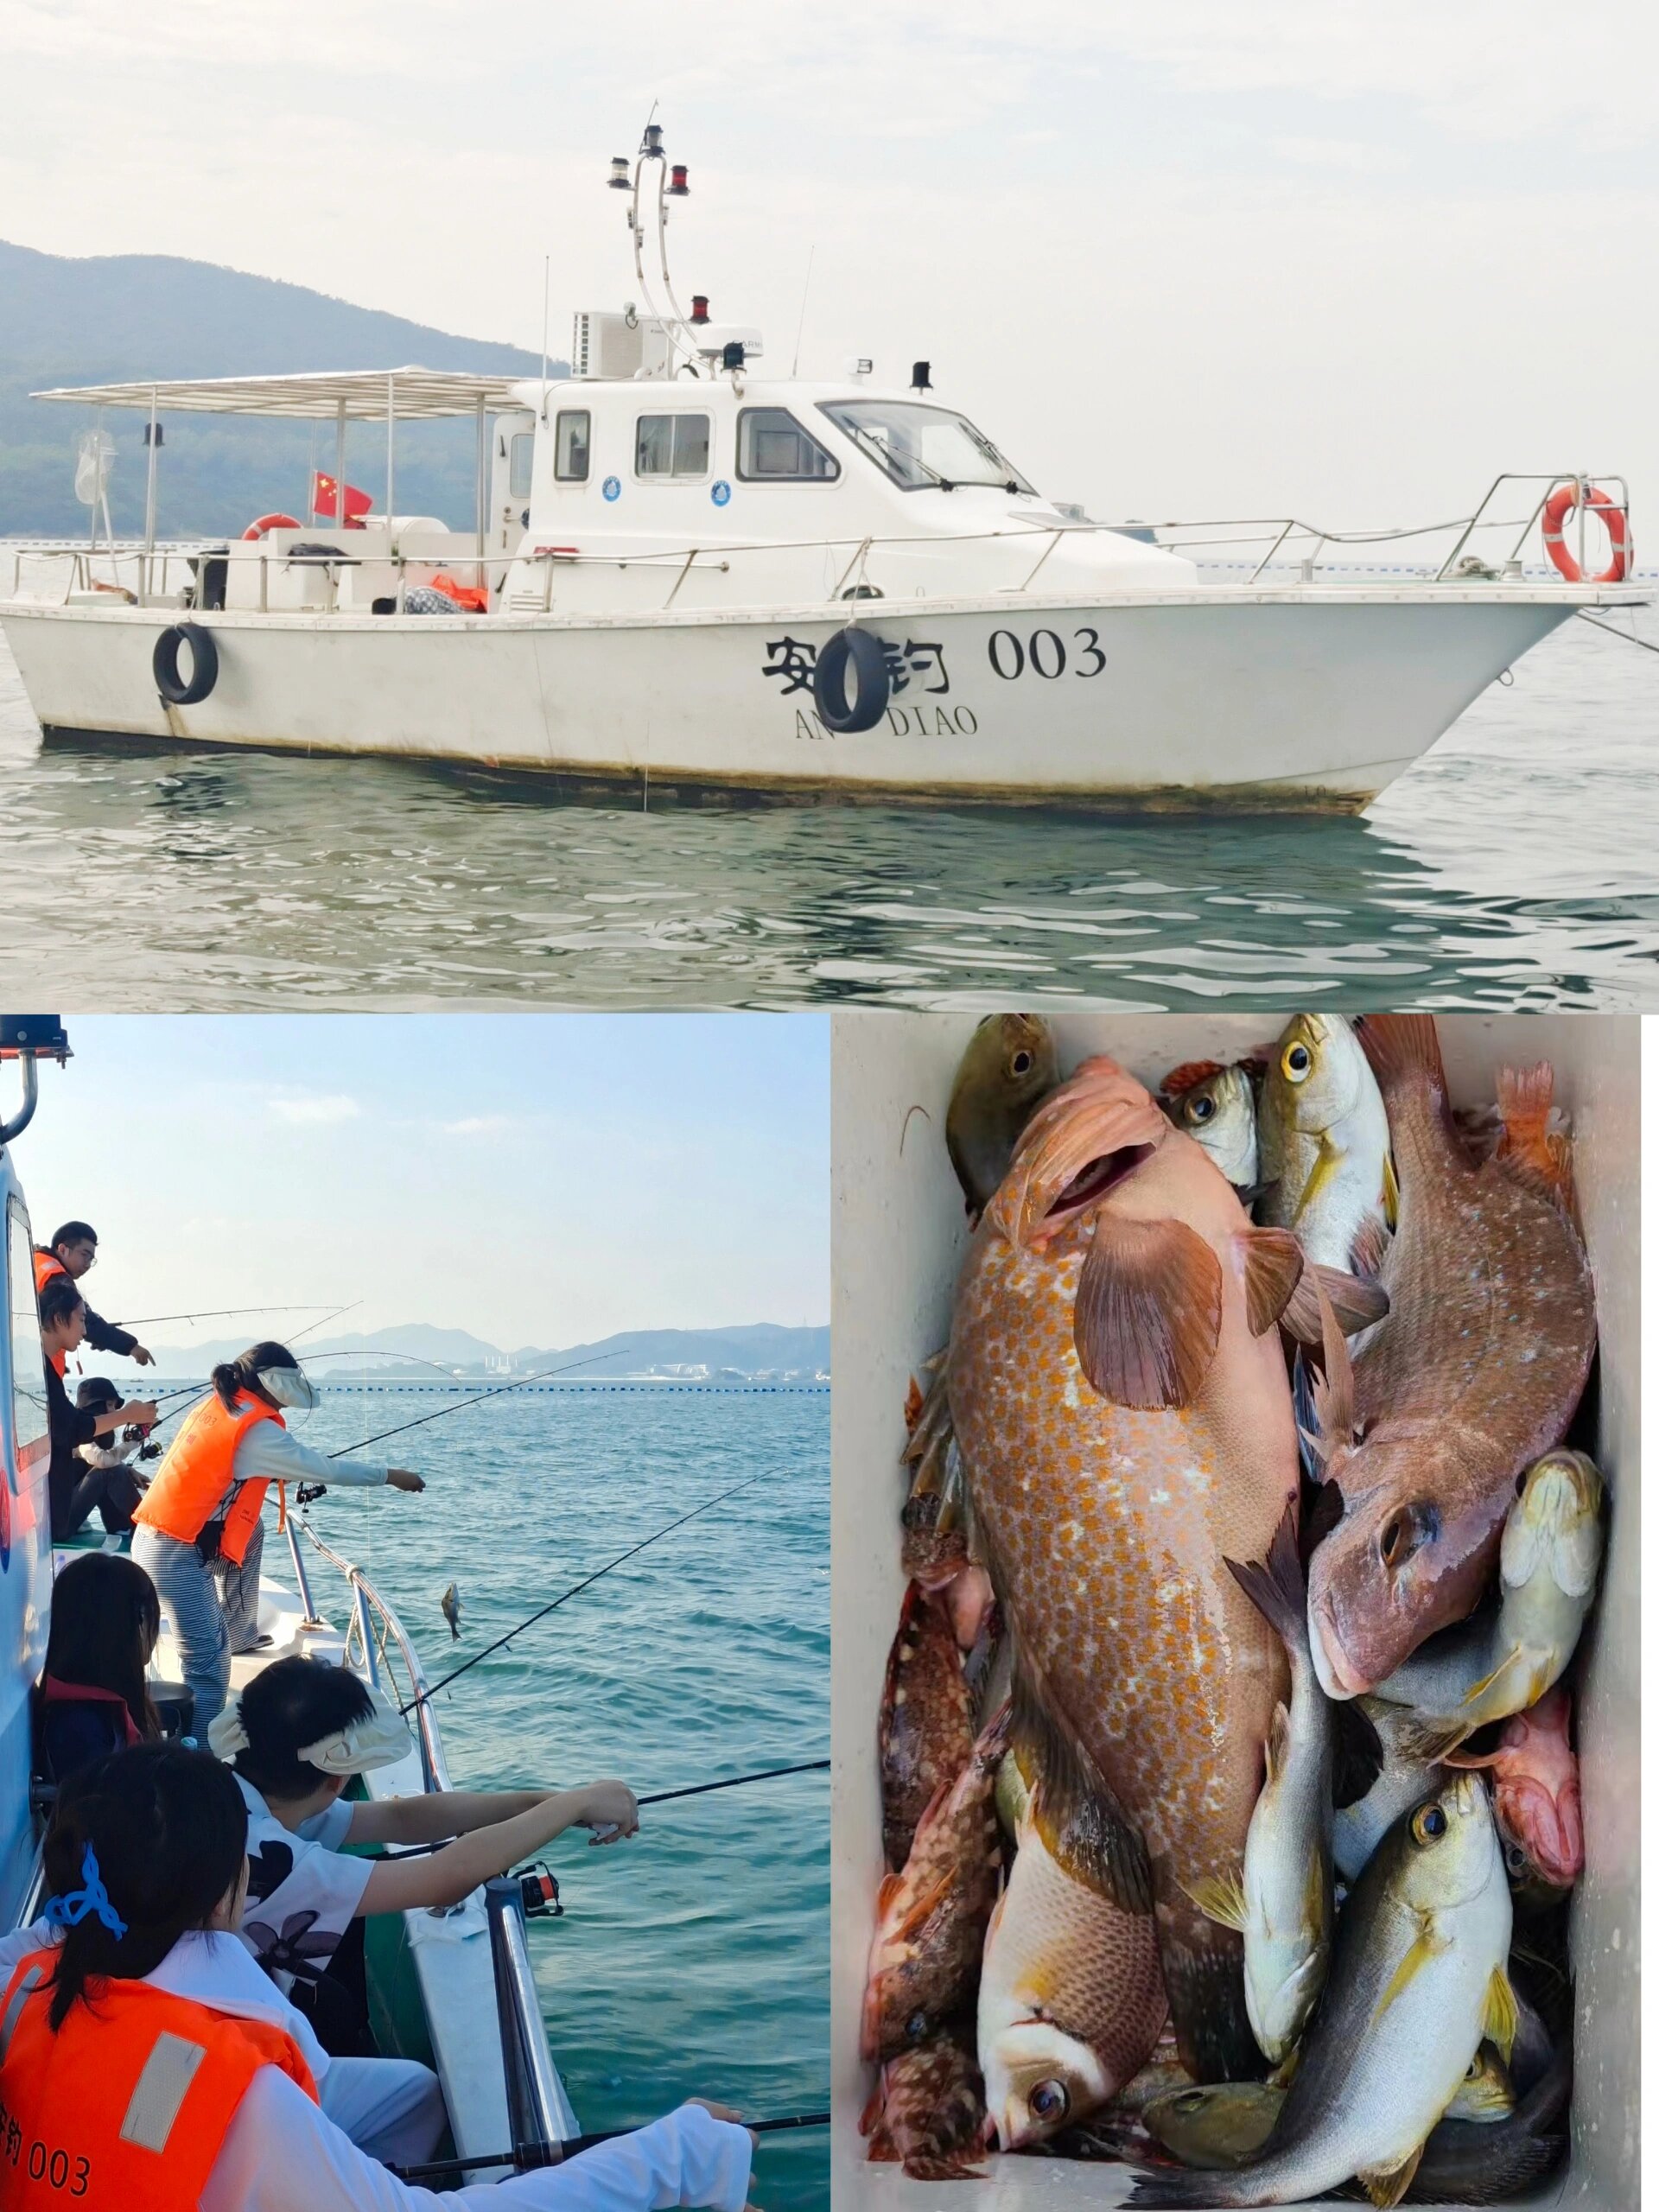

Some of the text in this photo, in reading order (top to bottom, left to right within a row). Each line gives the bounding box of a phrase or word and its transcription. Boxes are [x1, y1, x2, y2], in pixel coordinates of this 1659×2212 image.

[988, 627, 1107, 680] 003
[887, 705, 978, 736] DIAO
[198, 1412, 218, 1427] 003
[29, 2140, 91, 2196] 003
